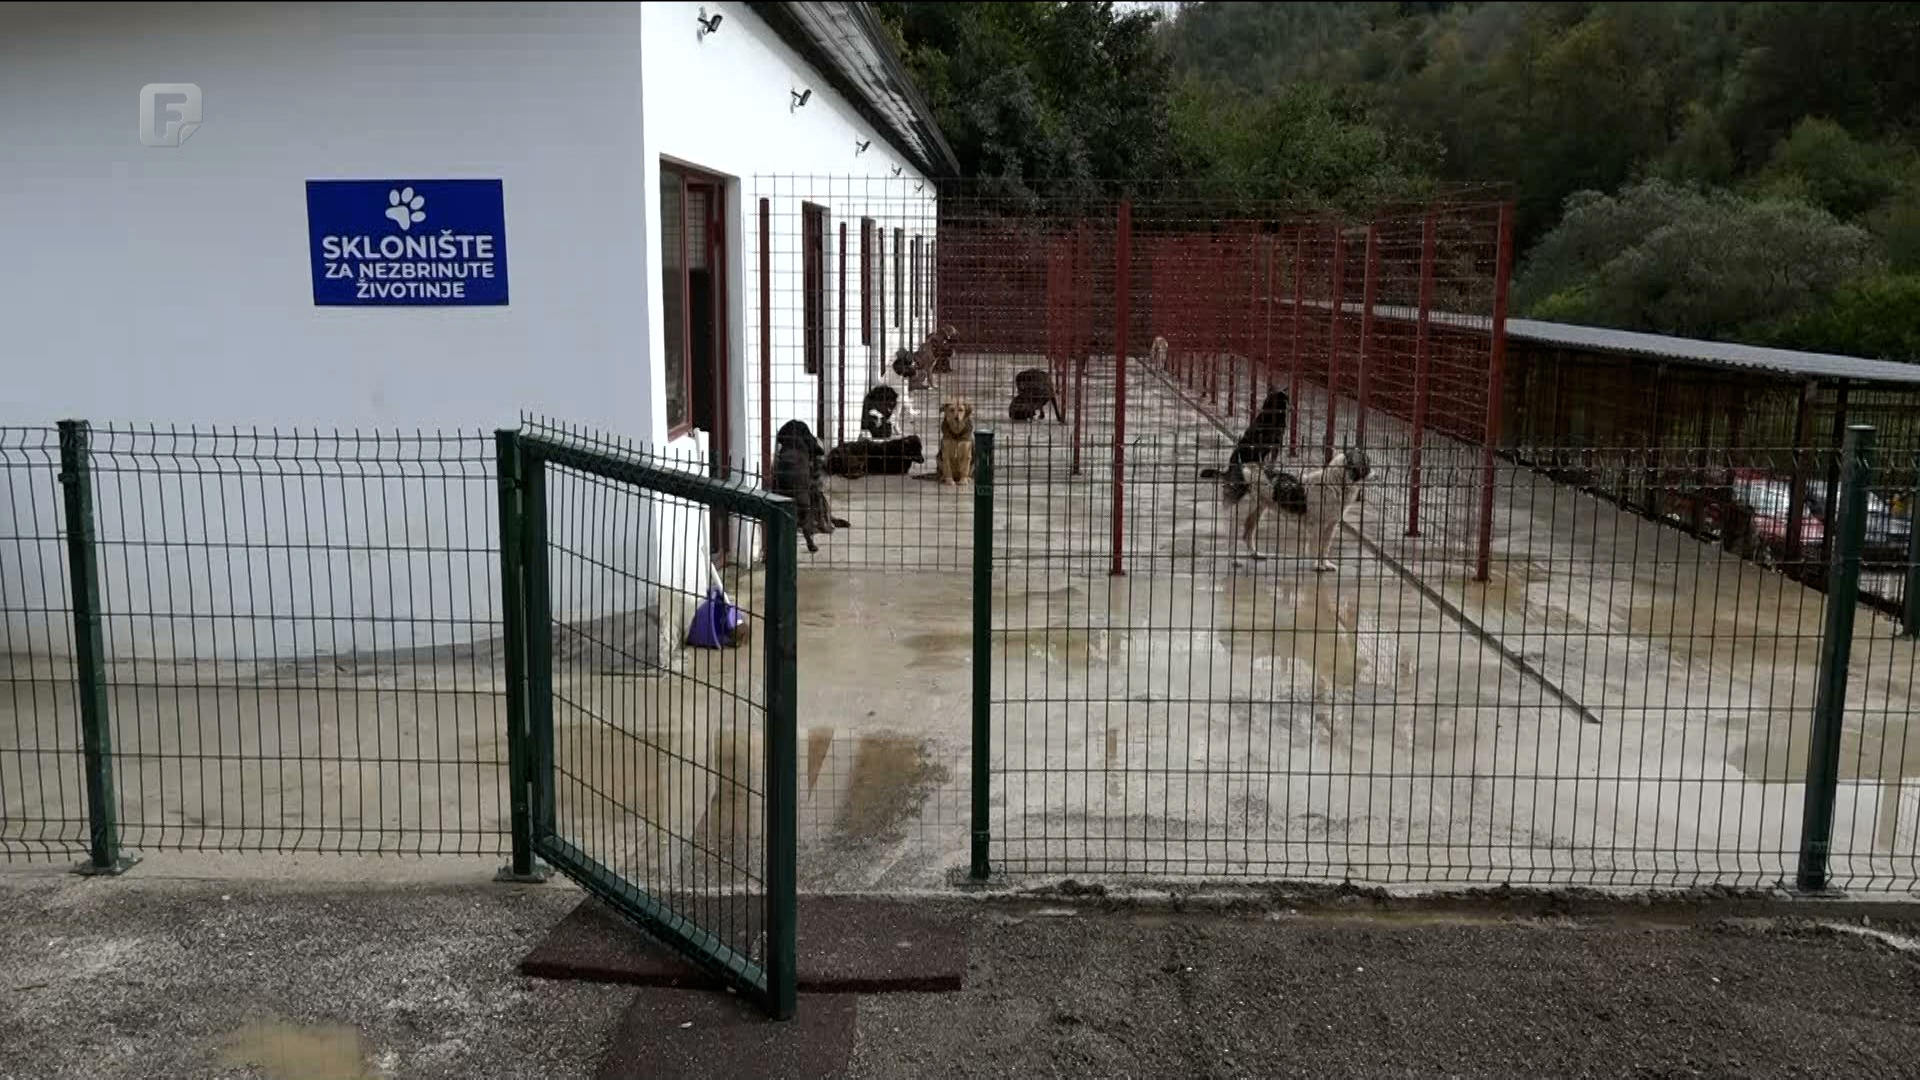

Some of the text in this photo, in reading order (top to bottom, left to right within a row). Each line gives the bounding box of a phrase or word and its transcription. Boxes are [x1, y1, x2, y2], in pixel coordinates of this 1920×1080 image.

[322, 229, 495, 260] SKLONIŠTE
[325, 262, 495, 279] ZA NEZBRINUTE
[356, 276, 466, 299] ŽIVOTINJE
